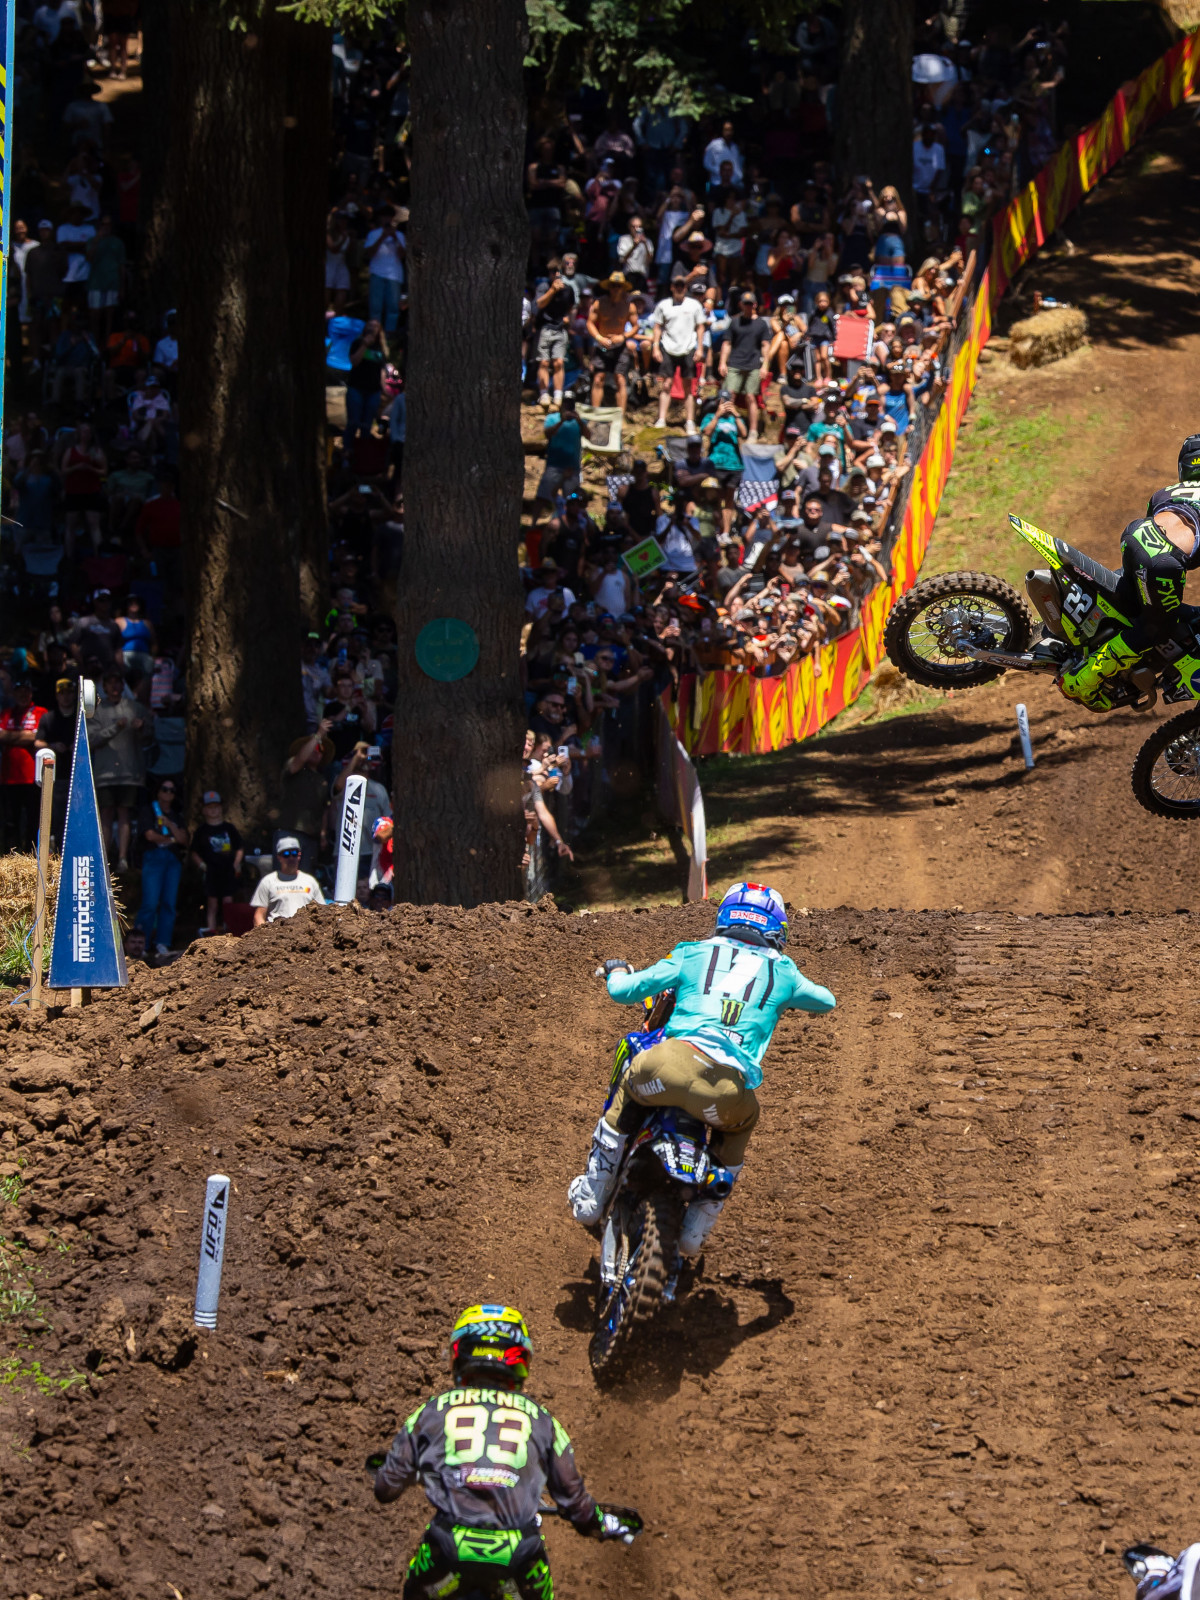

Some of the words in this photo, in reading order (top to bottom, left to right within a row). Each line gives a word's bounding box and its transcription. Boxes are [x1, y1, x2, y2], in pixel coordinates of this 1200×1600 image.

[1063, 583, 1093, 624] 22
[342, 804, 354, 852] UFO
[78, 856, 90, 962] MOTOCROSS
[729, 910, 769, 926] DANGER
[204, 1209, 218, 1261] UFO
[437, 1388, 539, 1420] FORKNER
[444, 1404, 532, 1469] 83
